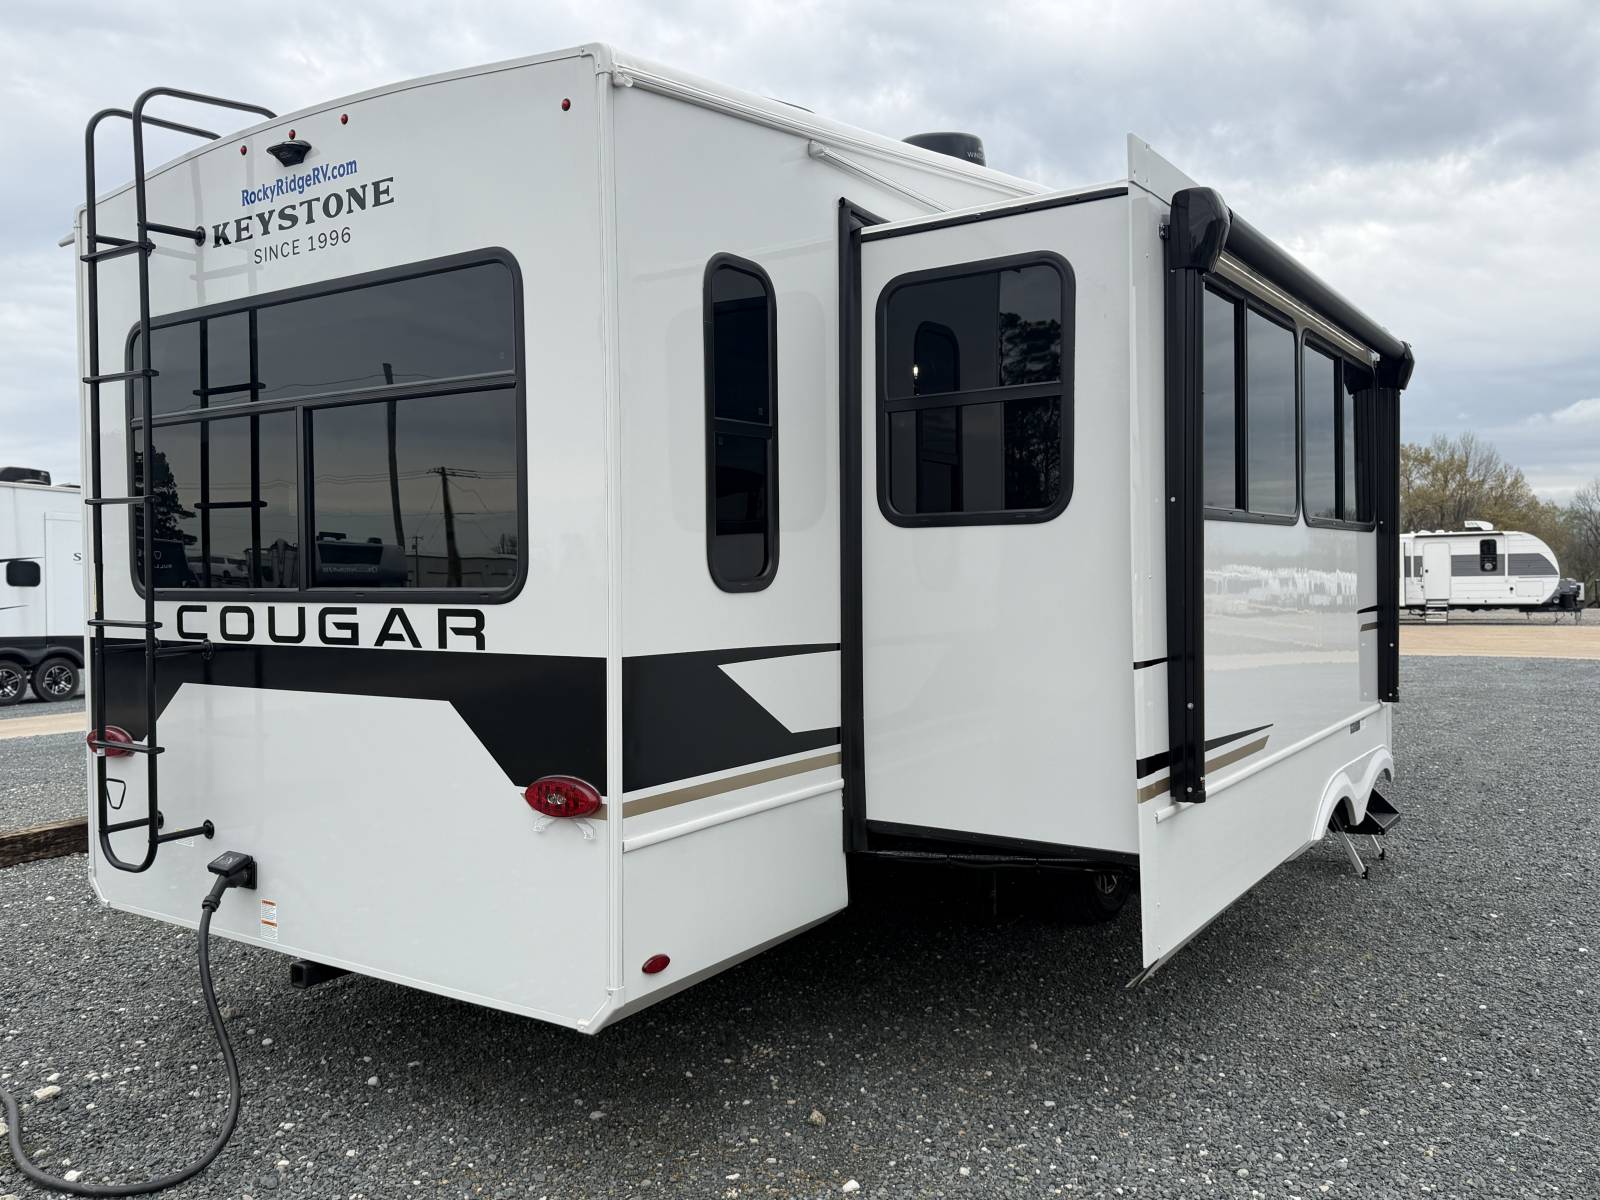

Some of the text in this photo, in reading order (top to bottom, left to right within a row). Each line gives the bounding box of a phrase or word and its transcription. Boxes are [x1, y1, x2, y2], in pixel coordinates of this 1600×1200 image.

[241, 159, 358, 206] RockyRidgeRV.com
[212, 177, 395, 248] KEYSTONE
[254, 226, 351, 264] SINCE 1996
[177, 604, 486, 651] COUGAR
